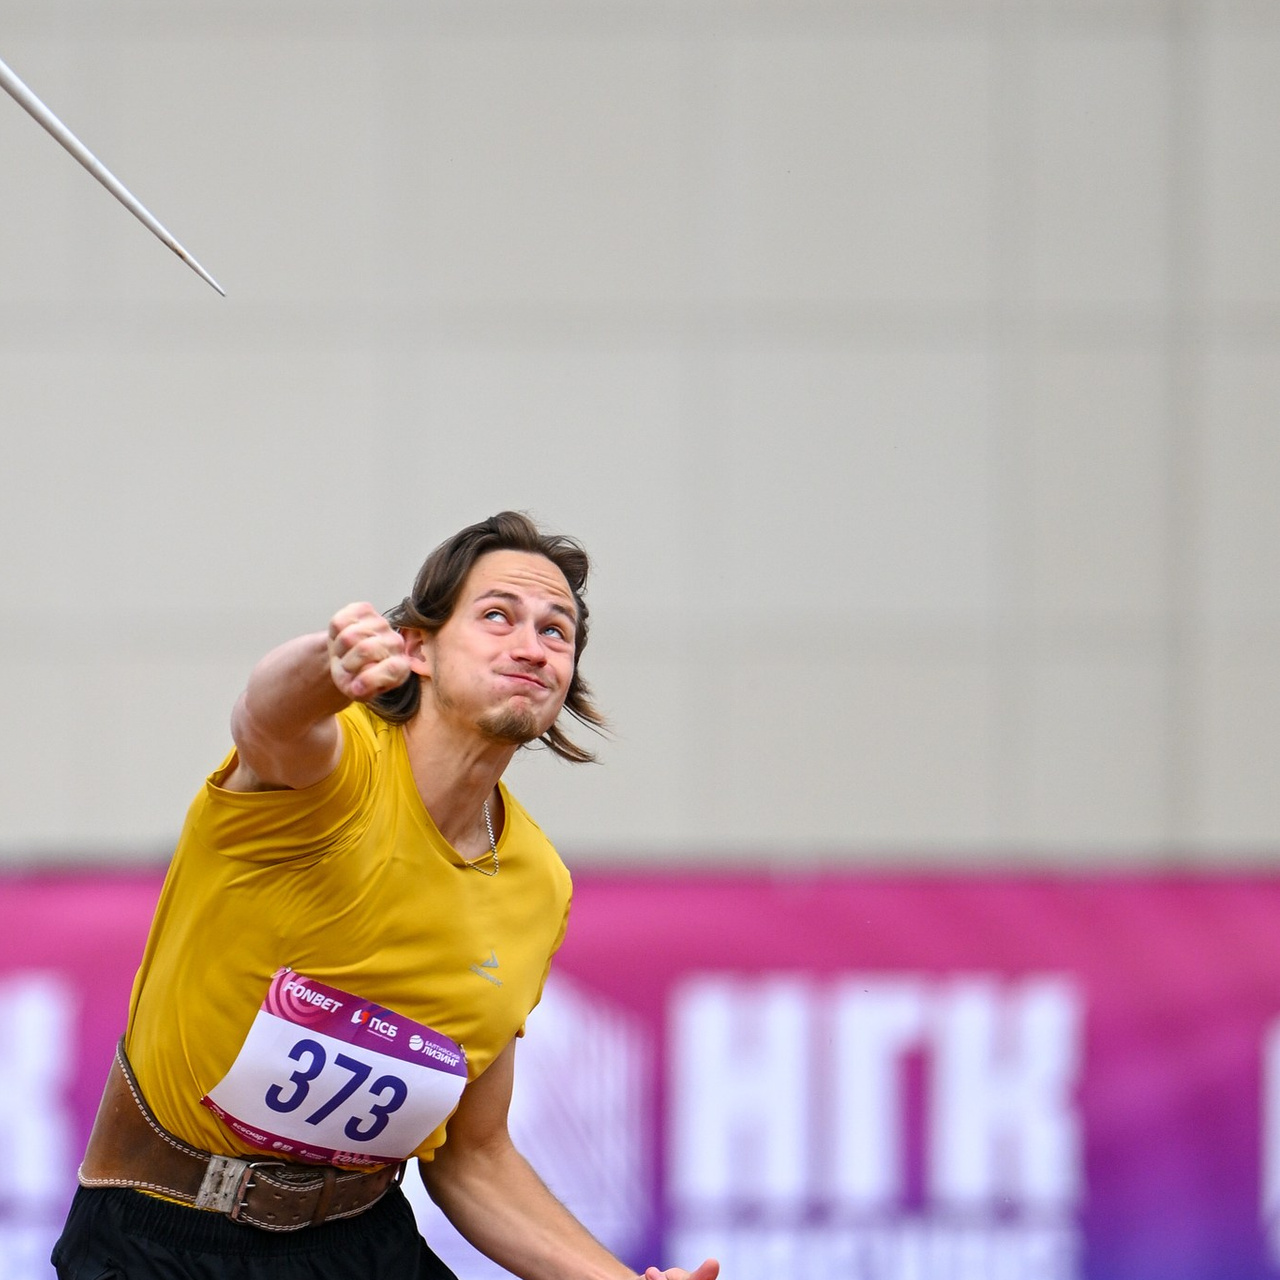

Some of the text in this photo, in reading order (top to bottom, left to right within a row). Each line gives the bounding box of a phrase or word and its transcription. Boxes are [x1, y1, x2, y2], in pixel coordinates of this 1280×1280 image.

[283, 981, 343, 1013] FONBET
[368, 1017, 399, 1038] ПСБ
[421, 1046, 460, 1067] ЛИЗИНГ
[265, 1039, 408, 1142] 373
